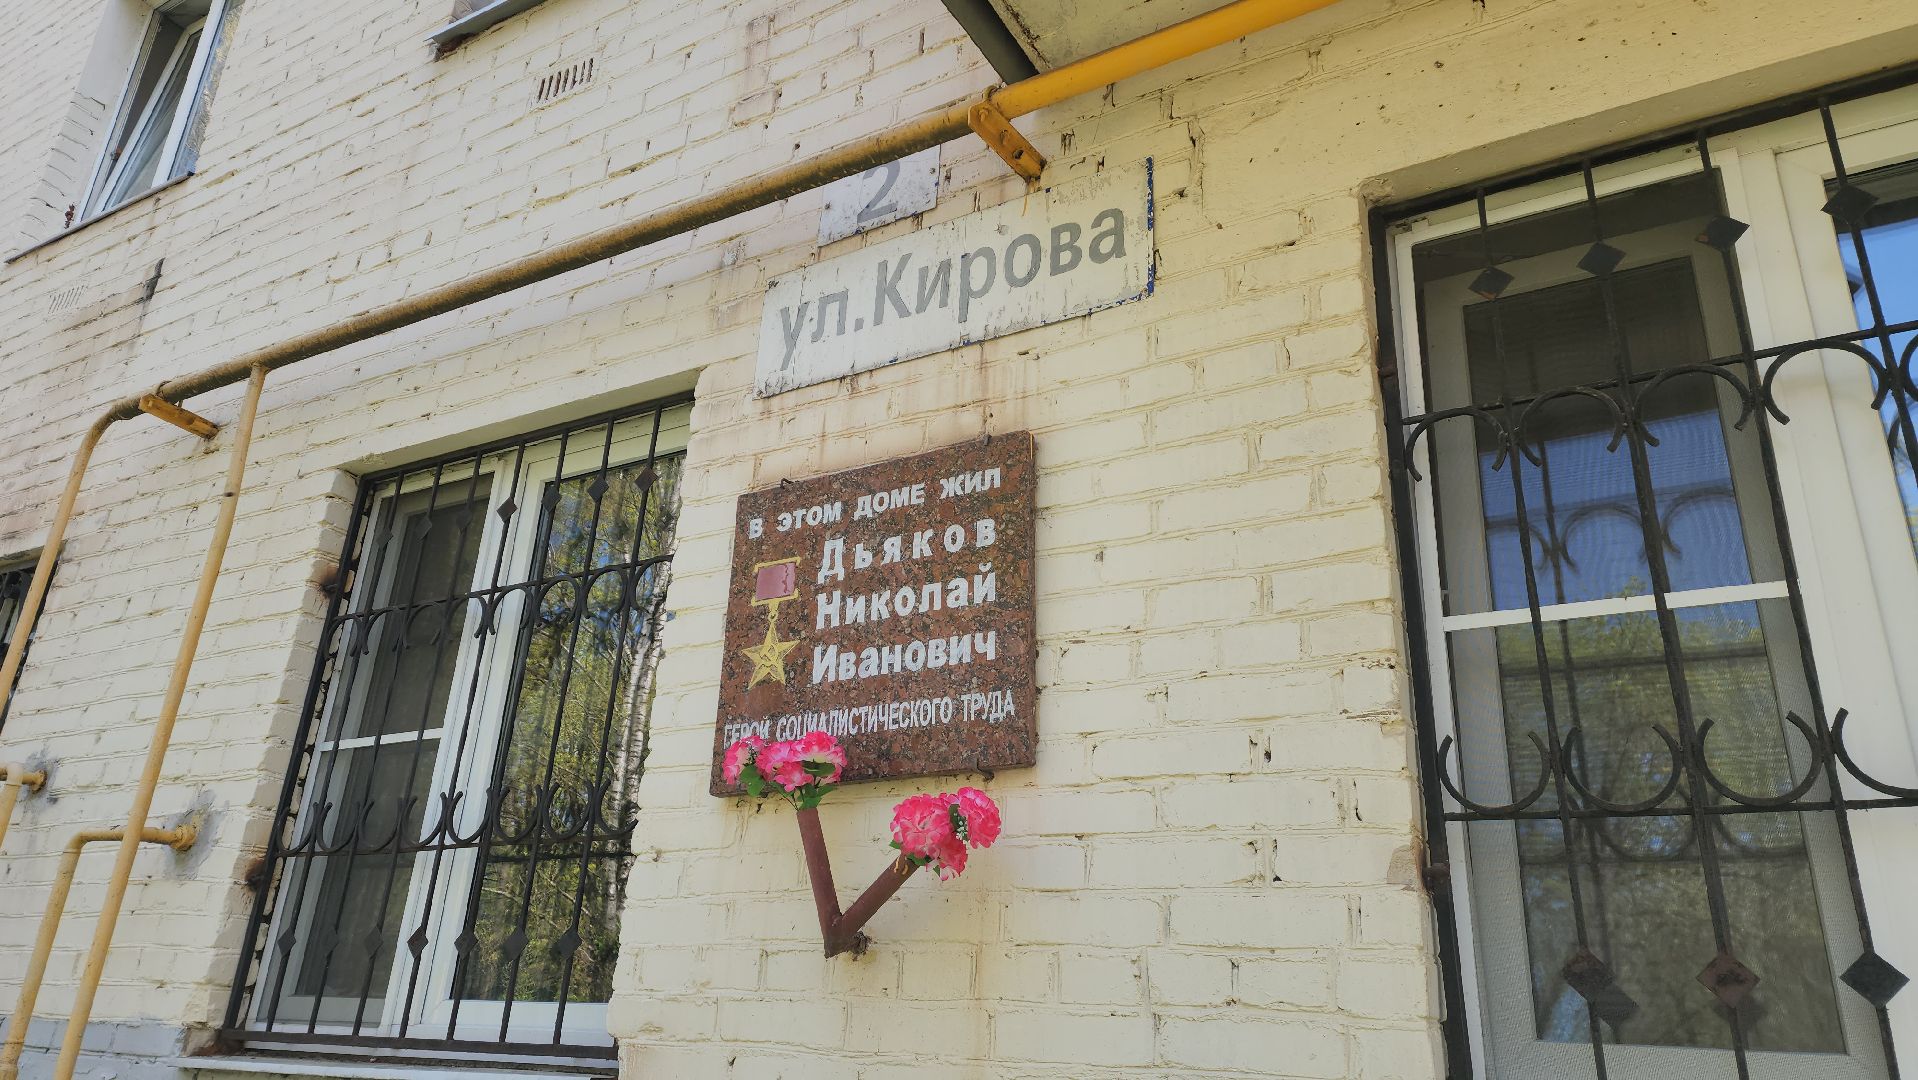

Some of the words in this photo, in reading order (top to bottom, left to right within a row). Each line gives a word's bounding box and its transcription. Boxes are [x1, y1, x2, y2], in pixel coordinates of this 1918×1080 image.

[857, 159, 900, 224] 2
[748, 518, 763, 539] В
[777, 502, 842, 532] ЭТОМ
[854, 483, 925, 521] ДОМЕ
[940, 467, 1001, 499] ЖИЛ
[816, 562, 996, 630] Николай
[812, 631, 996, 684] Иванович
[776, 697, 951, 742] СОЦИАЛИСТИЧЕСКОГО
[961, 689, 1015, 724] ТРУДА
